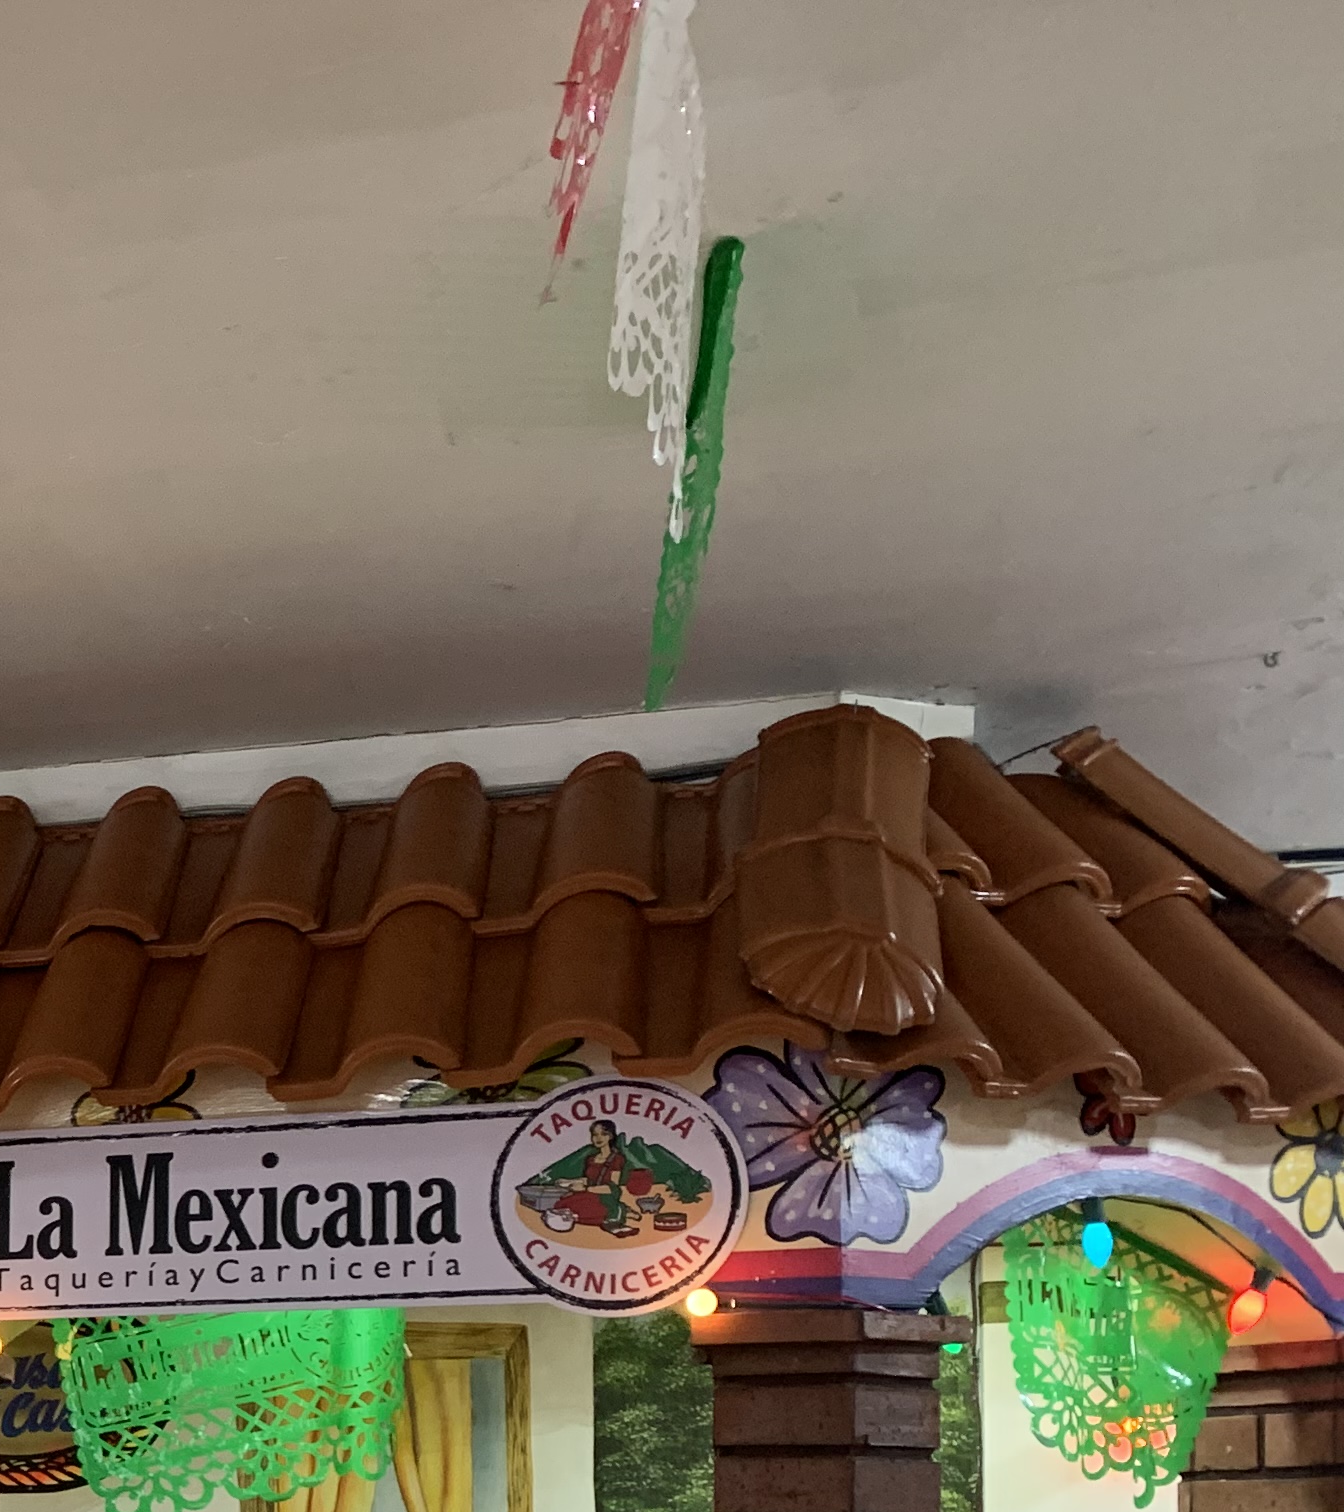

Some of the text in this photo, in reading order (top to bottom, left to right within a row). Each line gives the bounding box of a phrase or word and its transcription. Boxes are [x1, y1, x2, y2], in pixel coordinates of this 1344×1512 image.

[529, 1093, 699, 1147] TAQUERIA
[106, 1151, 461, 1258] Mexicana
[522, 1230, 712, 1296] CARNICERIA
